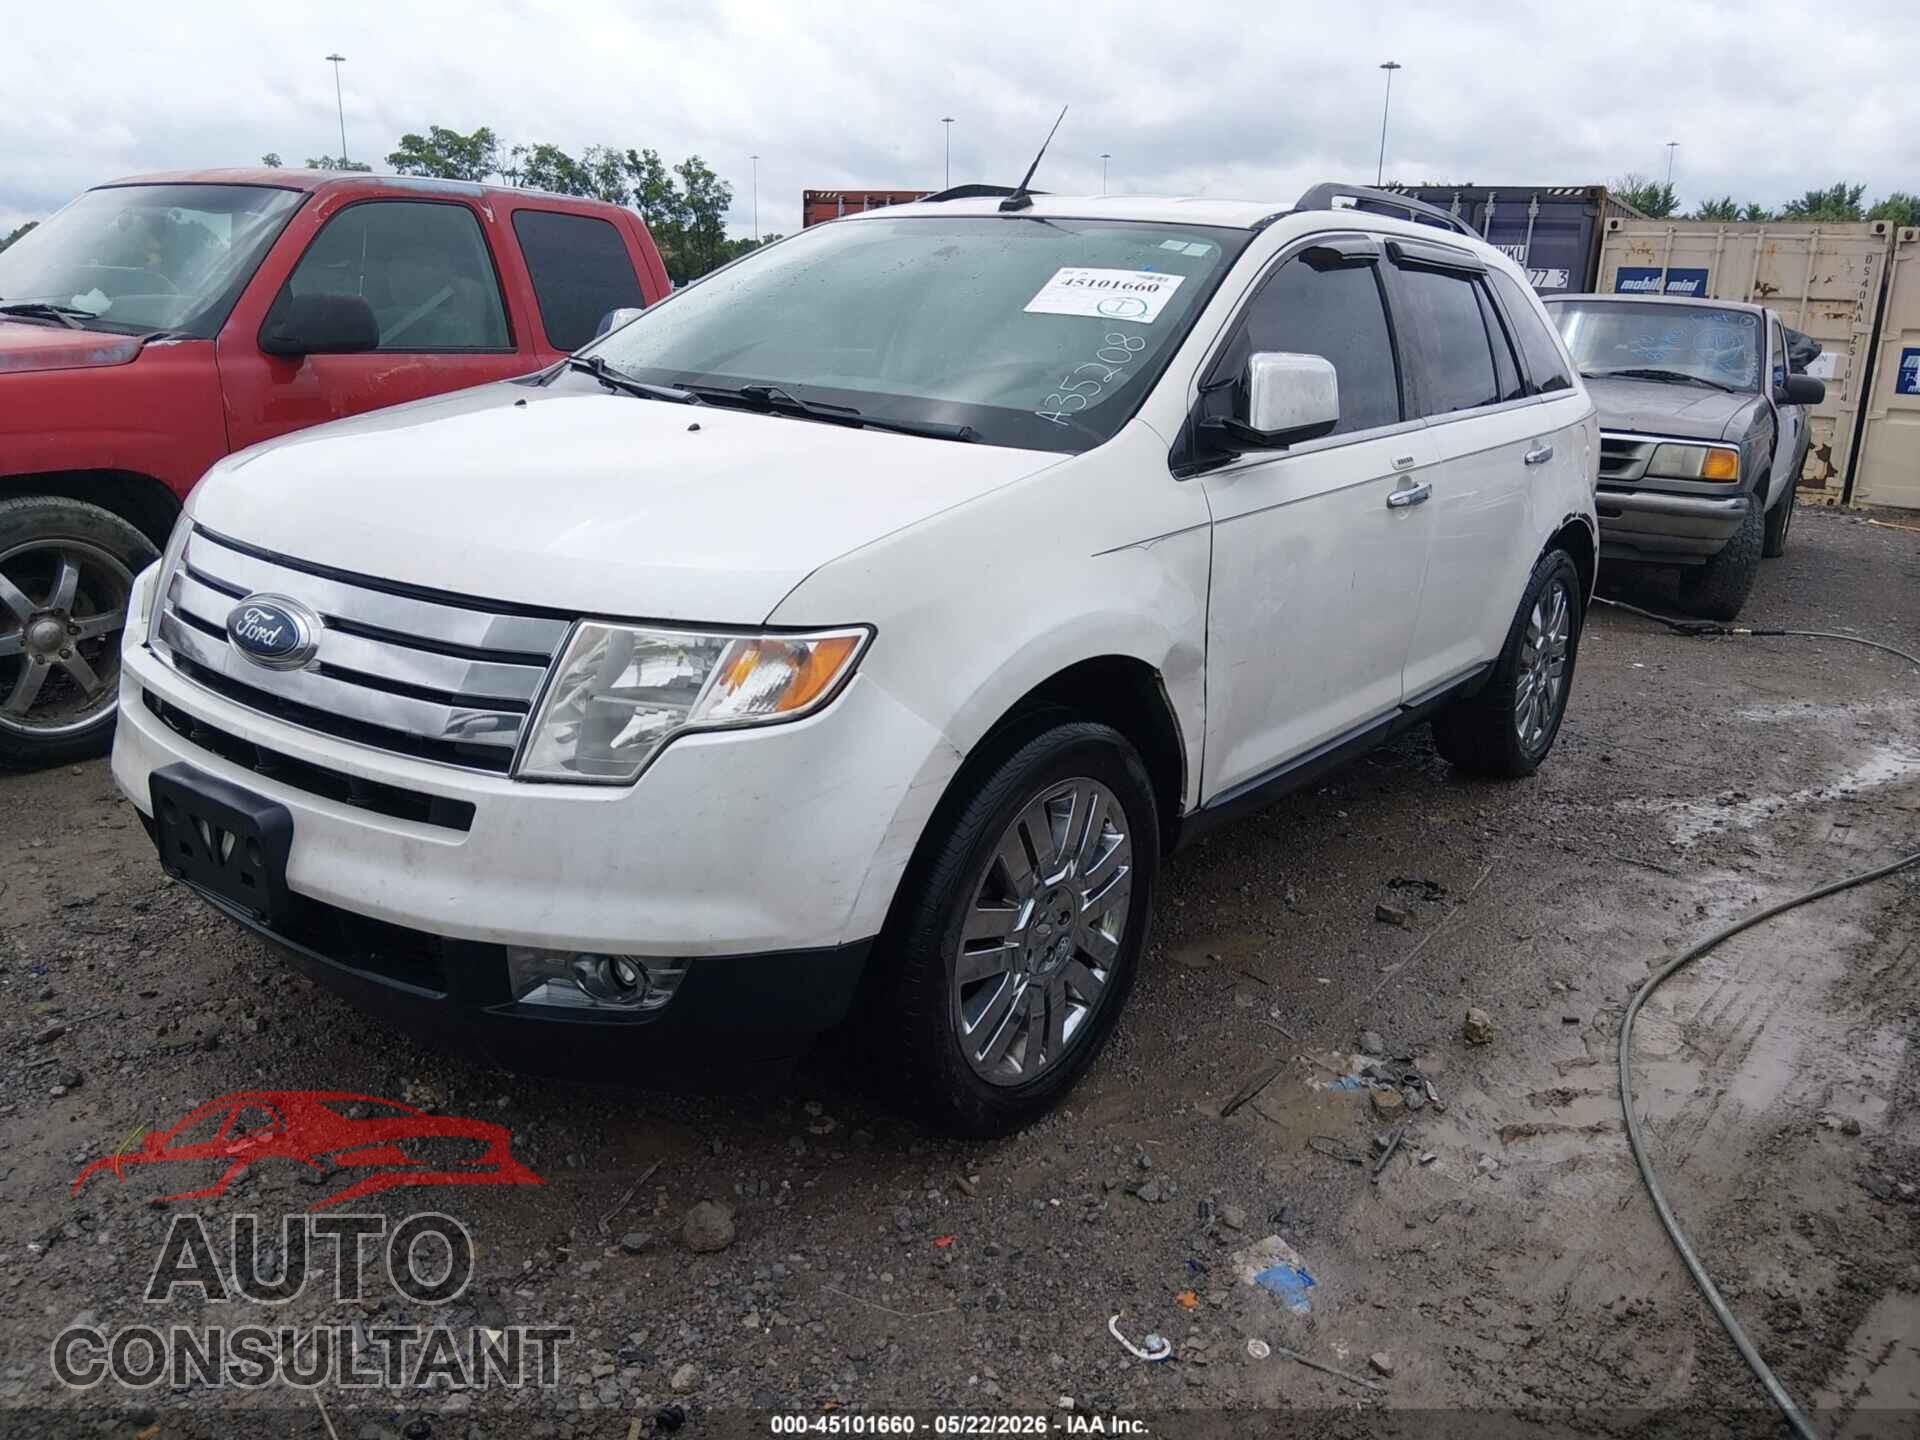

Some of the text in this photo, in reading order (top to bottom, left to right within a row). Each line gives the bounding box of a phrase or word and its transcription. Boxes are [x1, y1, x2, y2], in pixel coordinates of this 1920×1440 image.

[1061, 278, 1160, 293] 45101660
[1557, 270, 1568, 287] 3
[1620, 276, 1700, 292] mobil mini
[235, 607, 283, 647] Ford
